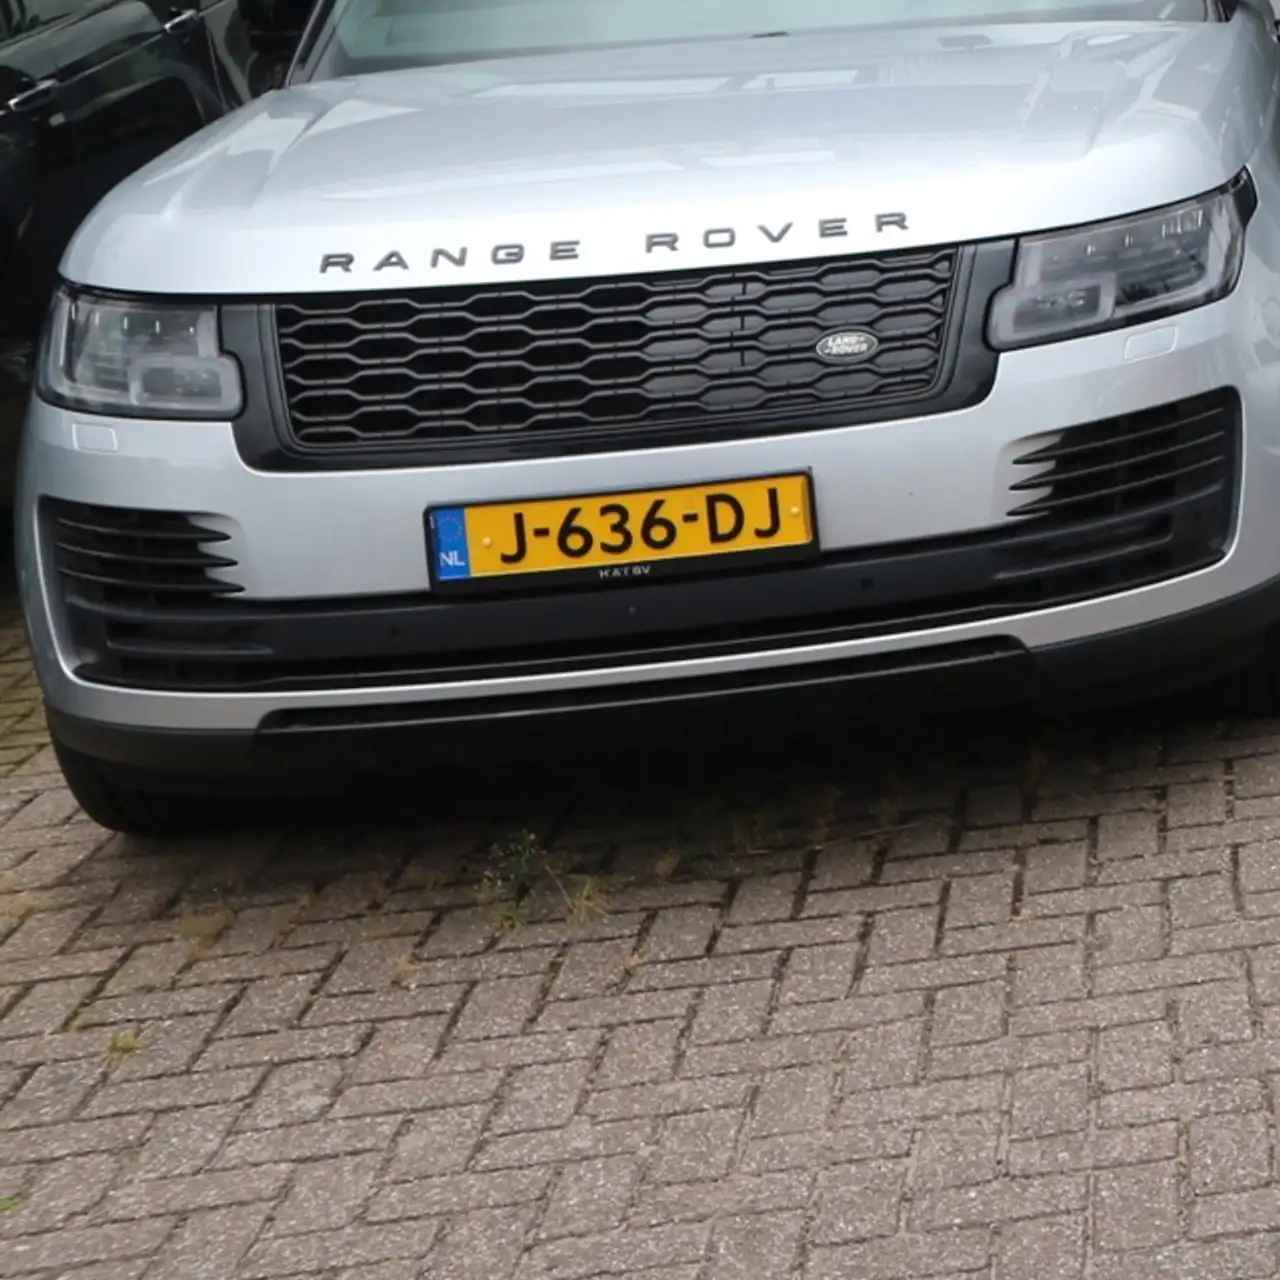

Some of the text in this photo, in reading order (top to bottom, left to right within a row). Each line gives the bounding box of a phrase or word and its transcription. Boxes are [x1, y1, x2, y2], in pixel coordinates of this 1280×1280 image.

[320, 211, 910, 274] RANGE ROVER
[499, 487, 782, 564] J-636-DJ
[440, 550, 466, 567] NL
